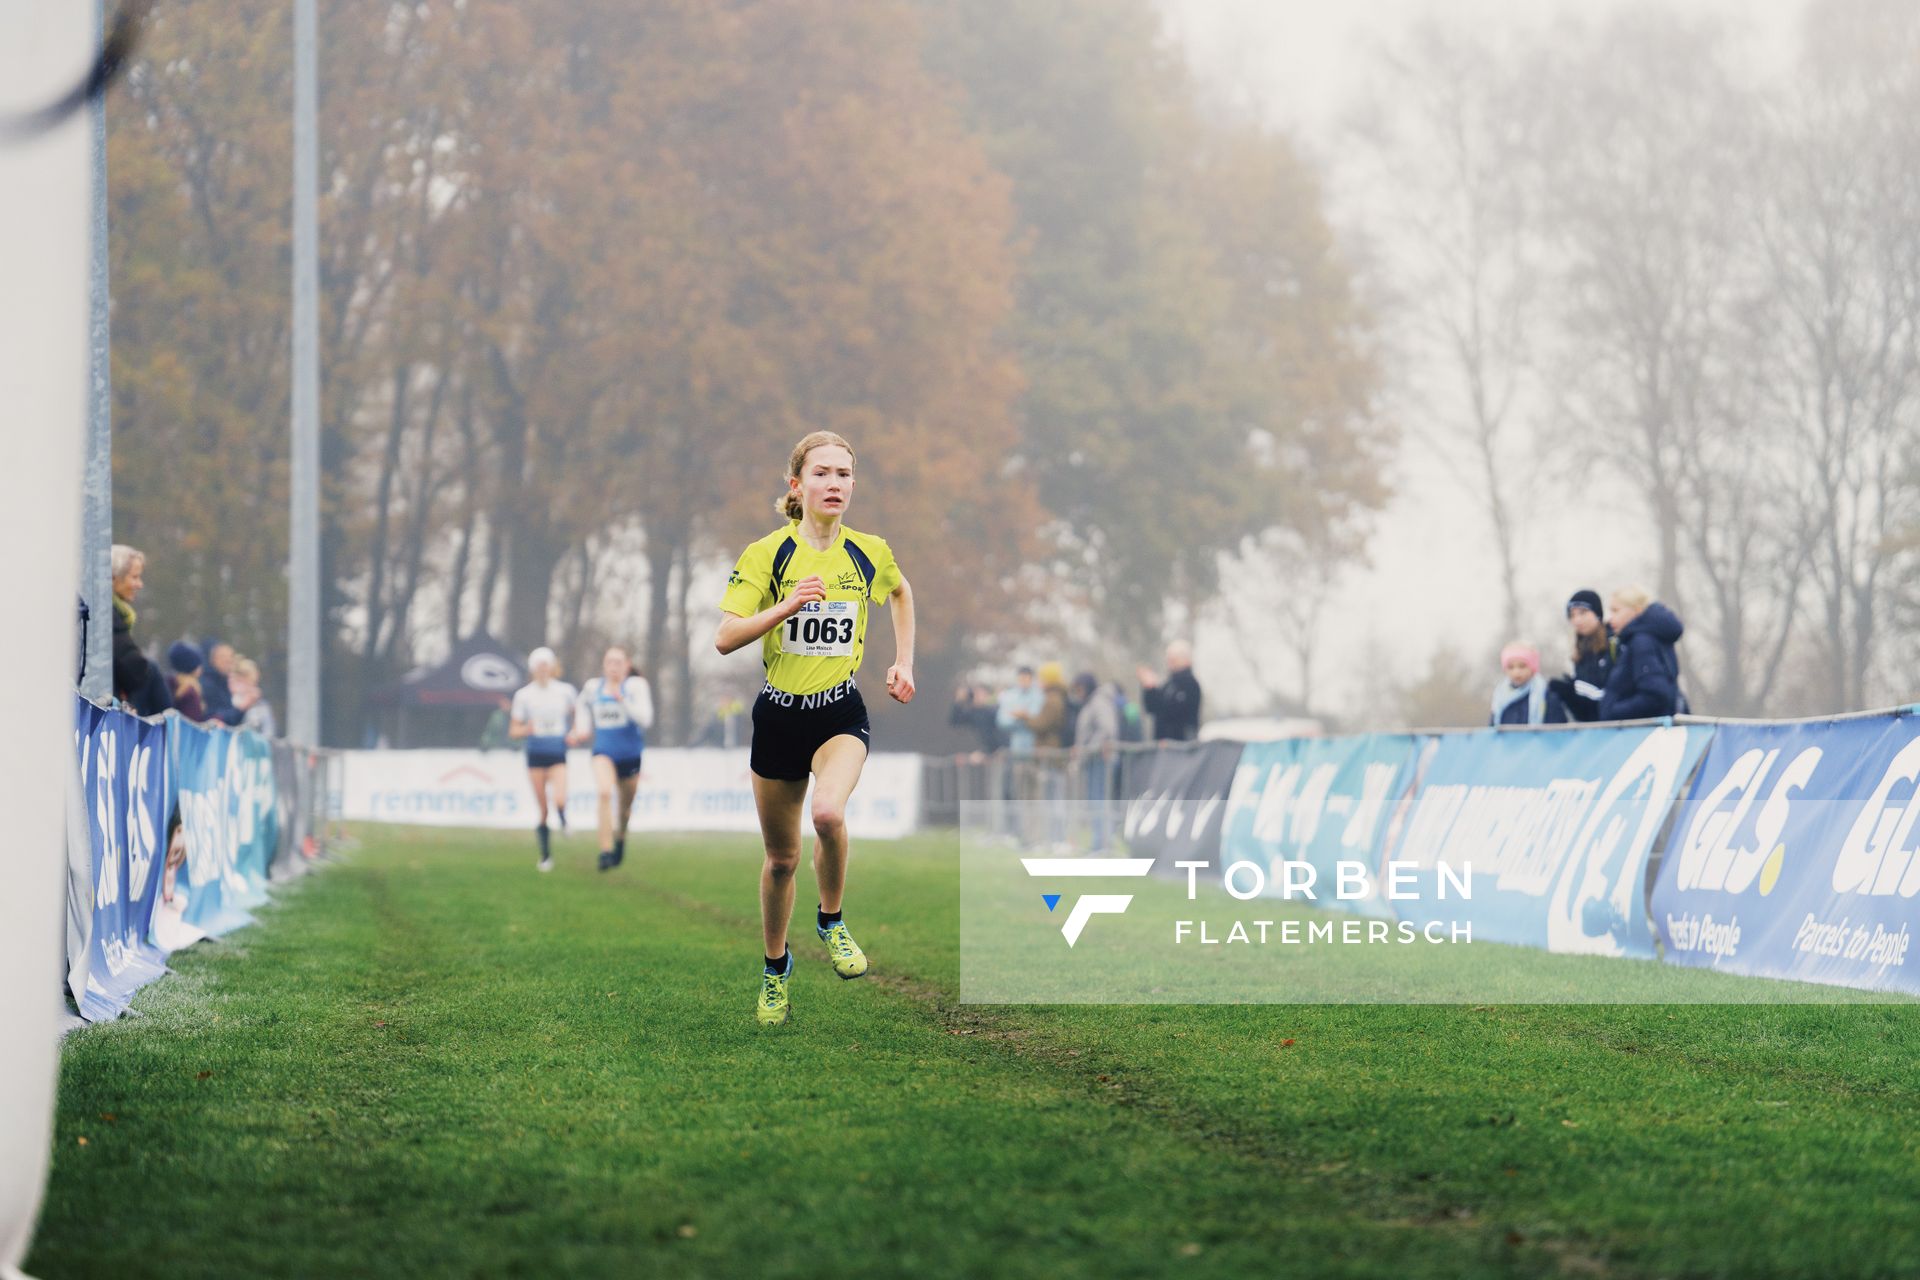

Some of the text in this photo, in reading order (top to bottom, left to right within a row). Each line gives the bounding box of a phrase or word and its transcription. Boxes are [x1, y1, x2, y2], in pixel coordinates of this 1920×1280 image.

[787, 616, 854, 644] 1063
[762, 682, 794, 708] PRO
[801, 683, 844, 710] NIKE
[1698, 913, 1741, 966] People
[1792, 912, 1909, 977] Parcels to People
